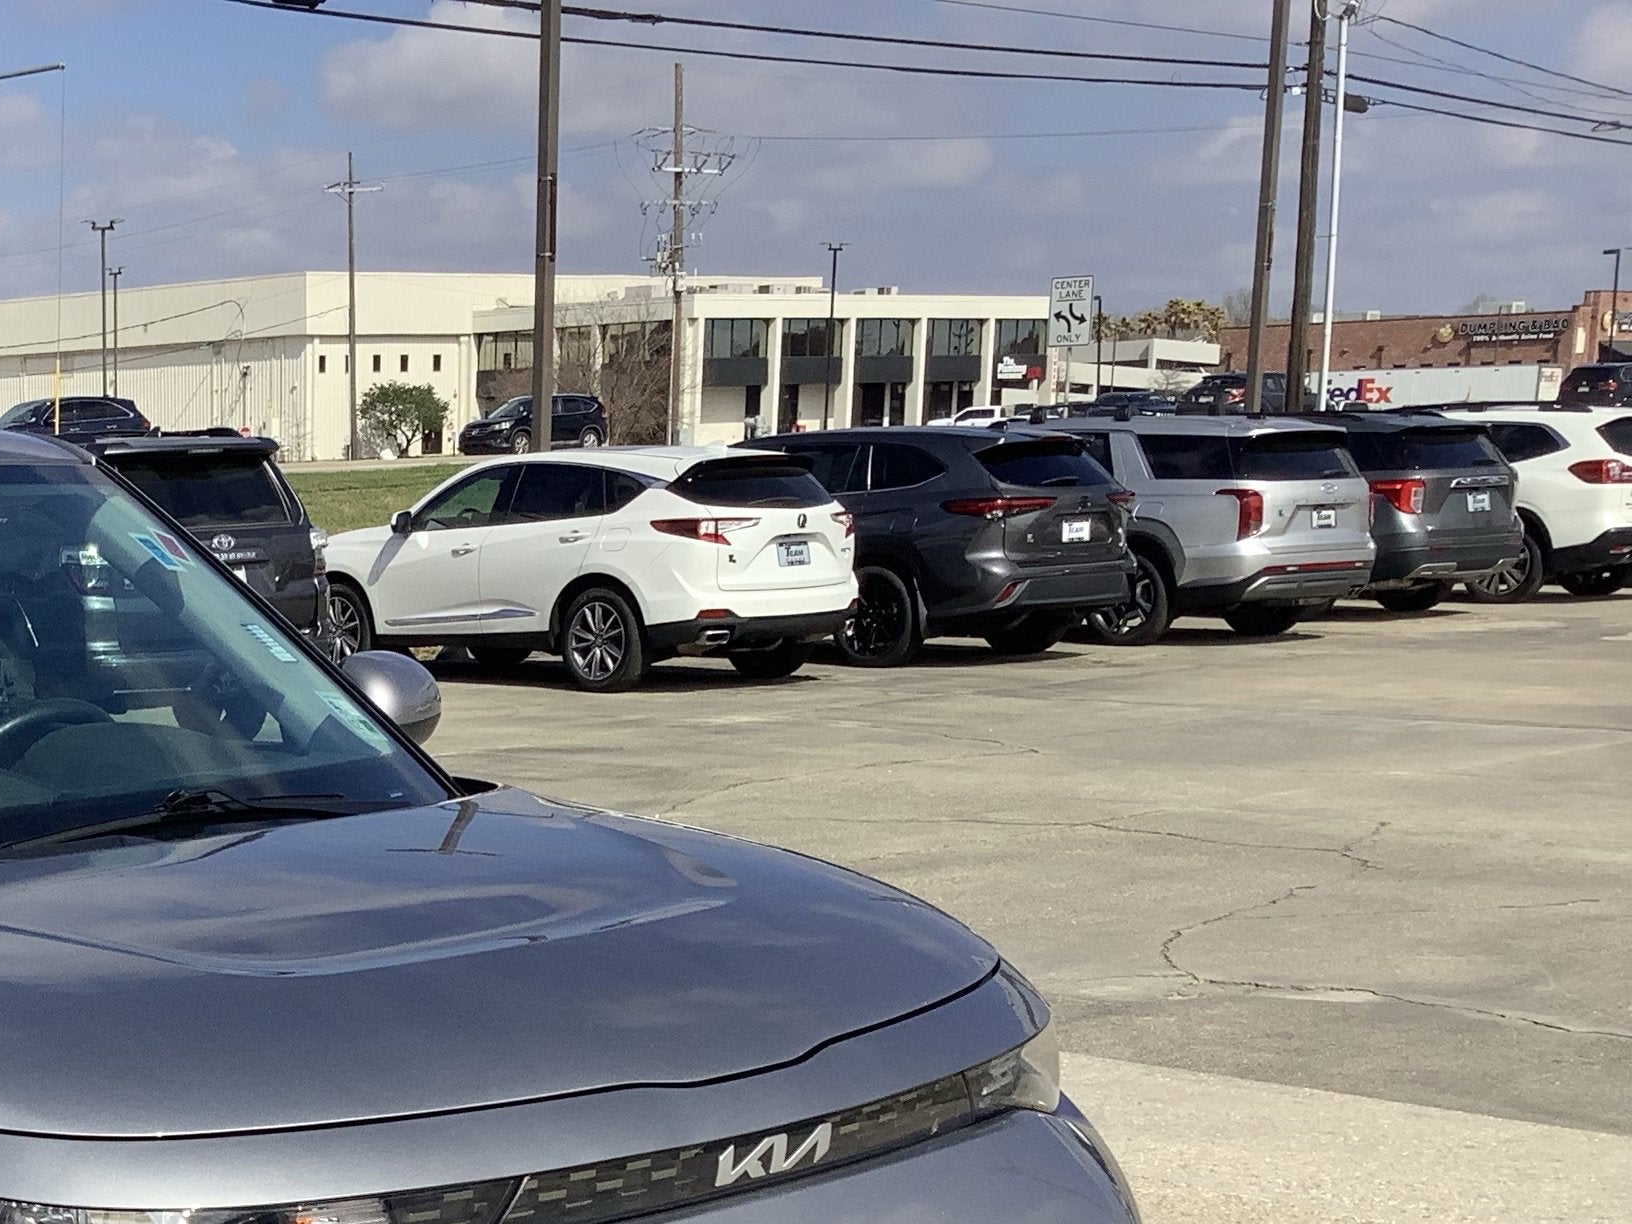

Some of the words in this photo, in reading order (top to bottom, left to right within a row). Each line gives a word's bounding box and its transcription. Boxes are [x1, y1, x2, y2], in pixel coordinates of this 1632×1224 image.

[1054, 279, 1090, 290] CENTER
[1060, 290, 1084, 299] LANE
[1458, 321, 1526, 335] DUMPING
[1056, 333, 1081, 344] ONLY
[785, 546, 804, 557] TEAM
[714, 1121, 833, 1187] KIA
